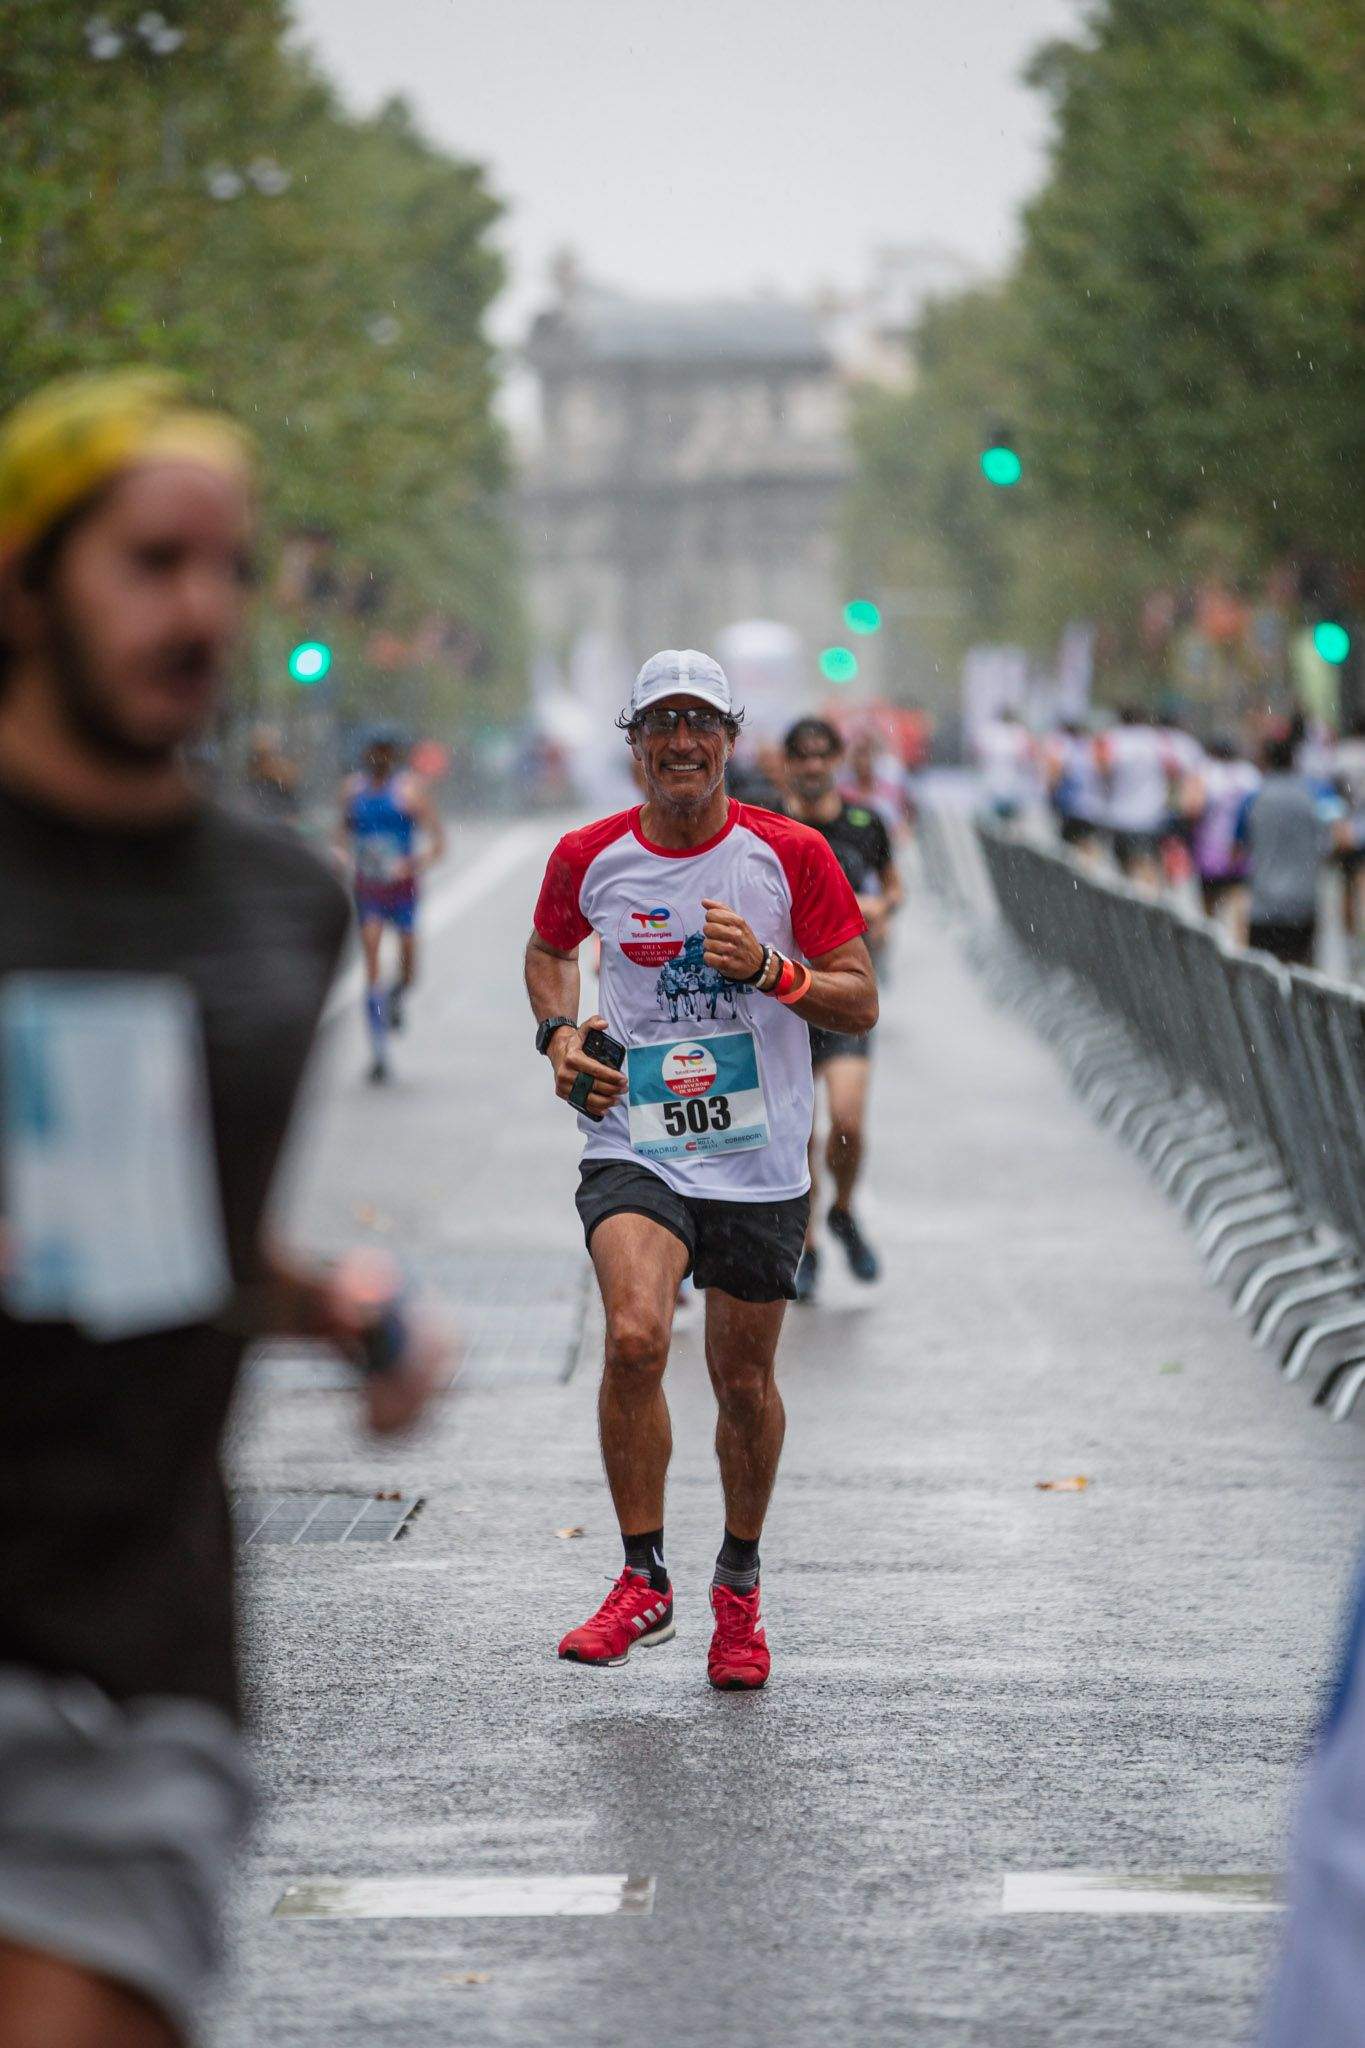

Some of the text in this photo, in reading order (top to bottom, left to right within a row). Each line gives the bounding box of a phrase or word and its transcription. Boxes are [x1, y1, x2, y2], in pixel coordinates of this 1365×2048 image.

[631, 931, 672, 939] TotalEnergies
[663, 1095, 731, 1137] 503
[647, 1145, 678, 1155] MADRID
